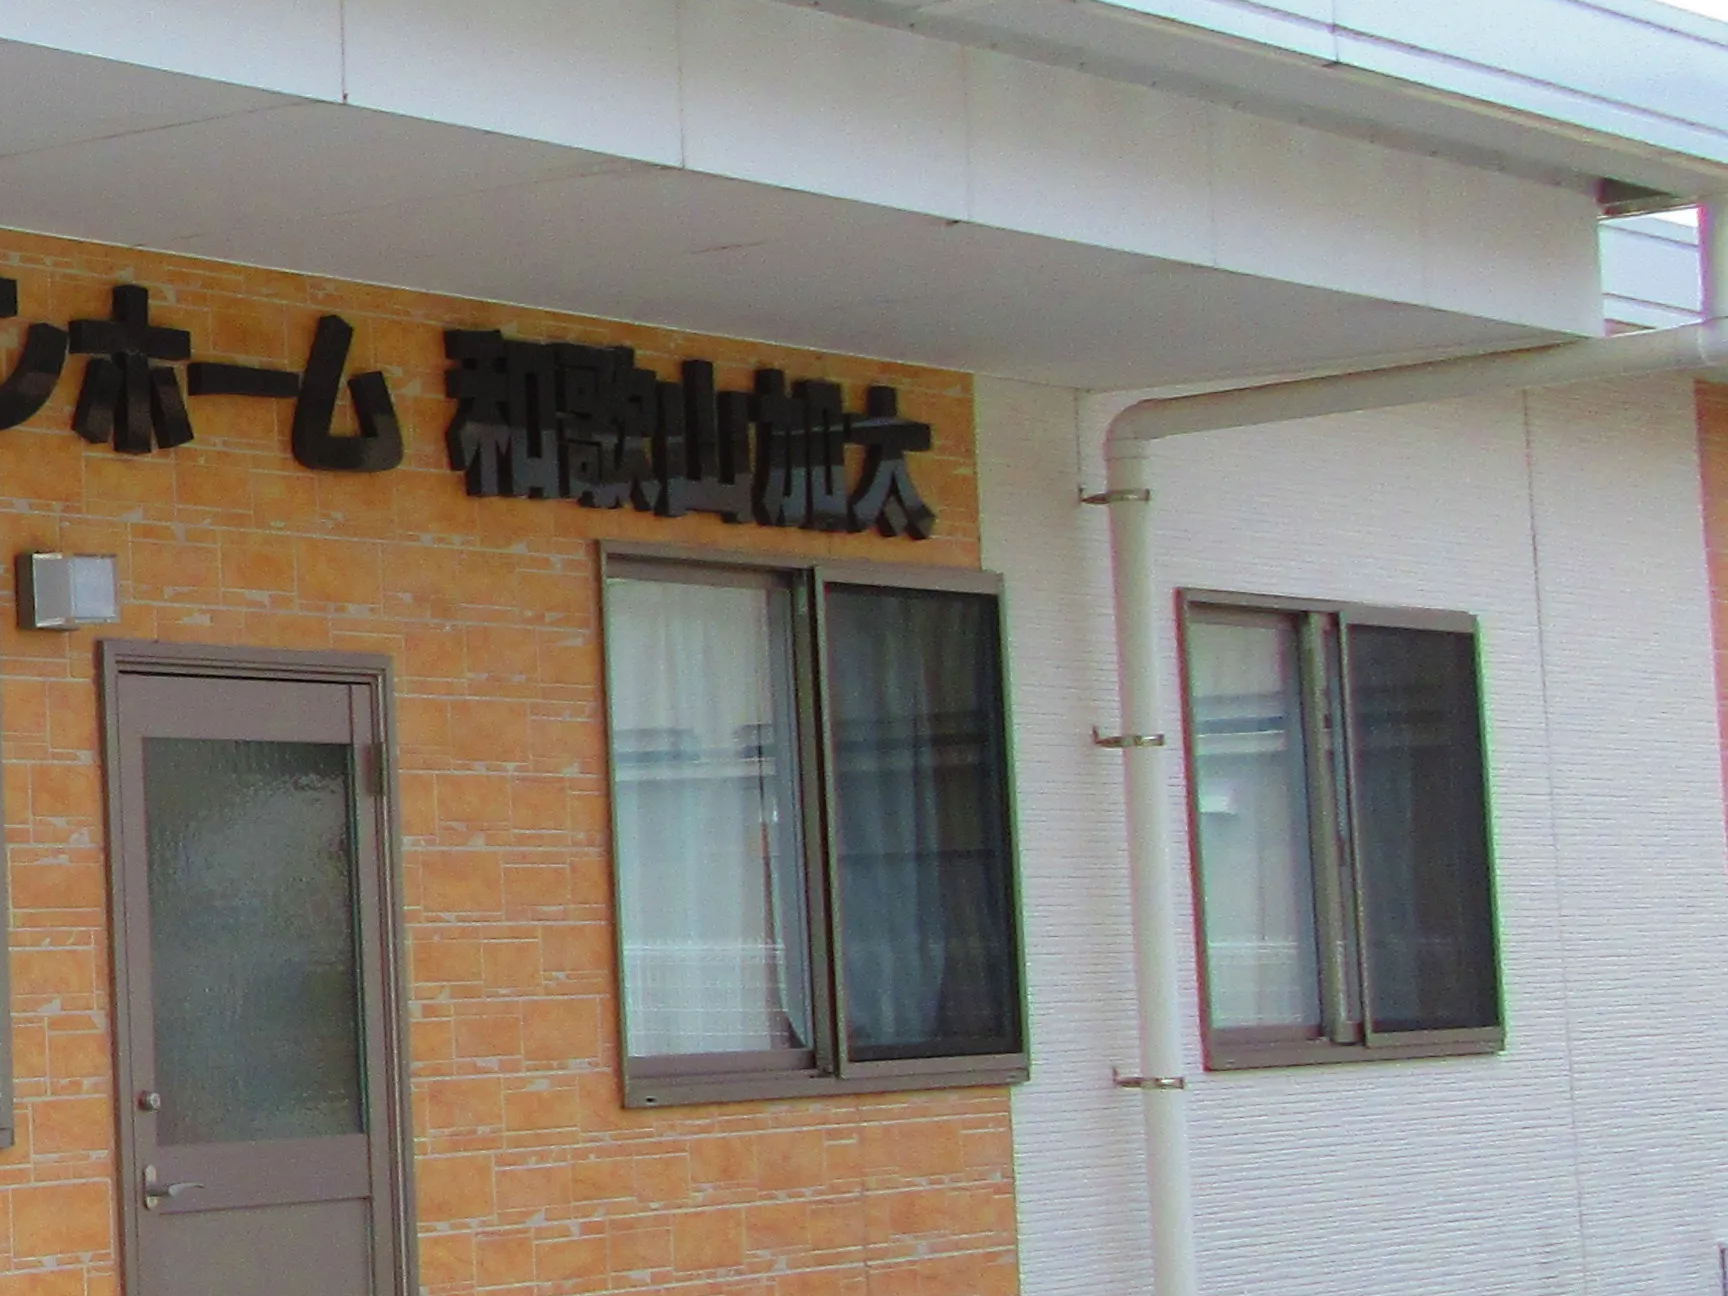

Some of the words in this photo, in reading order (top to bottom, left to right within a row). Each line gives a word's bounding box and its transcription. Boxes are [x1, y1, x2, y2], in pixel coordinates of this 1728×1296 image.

[444, 328, 934, 540] 和歌山加太
